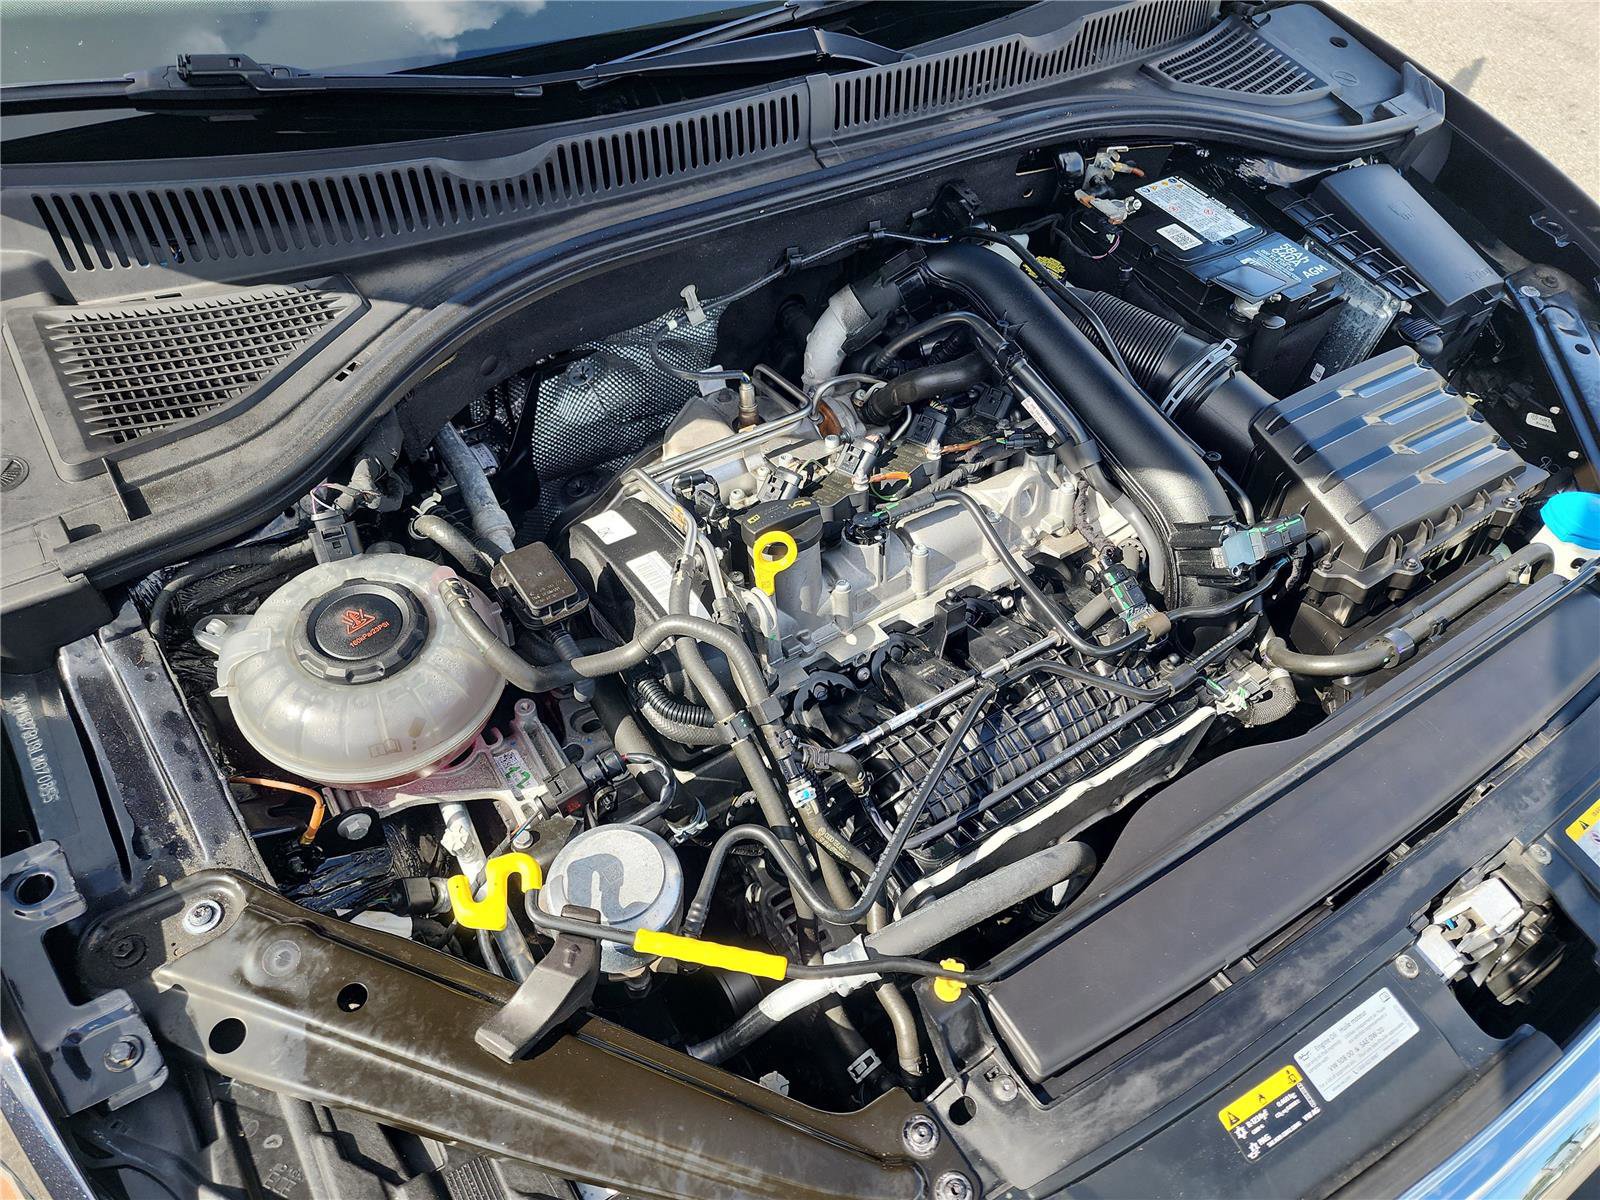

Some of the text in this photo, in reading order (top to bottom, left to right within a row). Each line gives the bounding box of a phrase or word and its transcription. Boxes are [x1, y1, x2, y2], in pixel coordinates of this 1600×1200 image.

[1272, 248, 1300, 267] 640A
[1280, 243, 1309, 264] 58Ah
[1302, 264, 1328, 279] AGM
